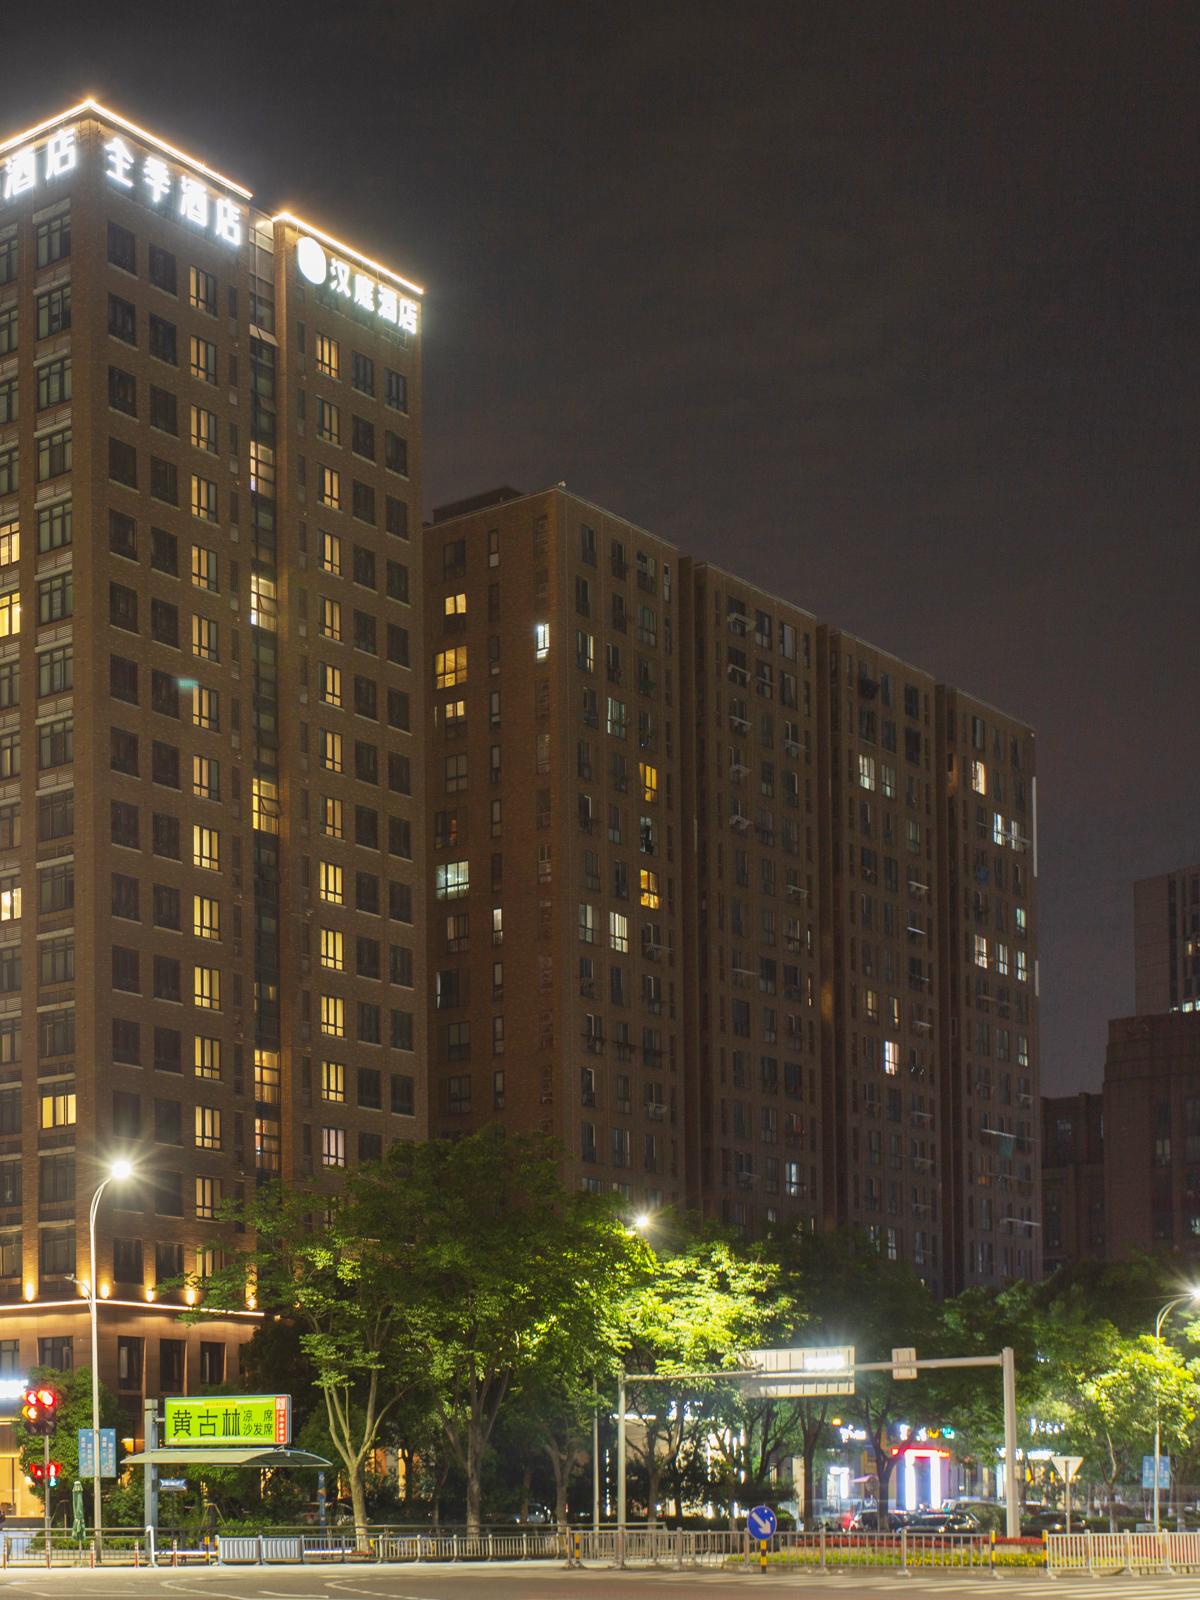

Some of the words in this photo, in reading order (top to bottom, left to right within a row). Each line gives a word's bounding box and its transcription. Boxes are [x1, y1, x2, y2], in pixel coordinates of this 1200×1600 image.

[104, 137, 241, 246] 全季酒店
[330, 257, 417, 335] 汉庭酒店
[172, 1408, 241, 1437] 黄古林
